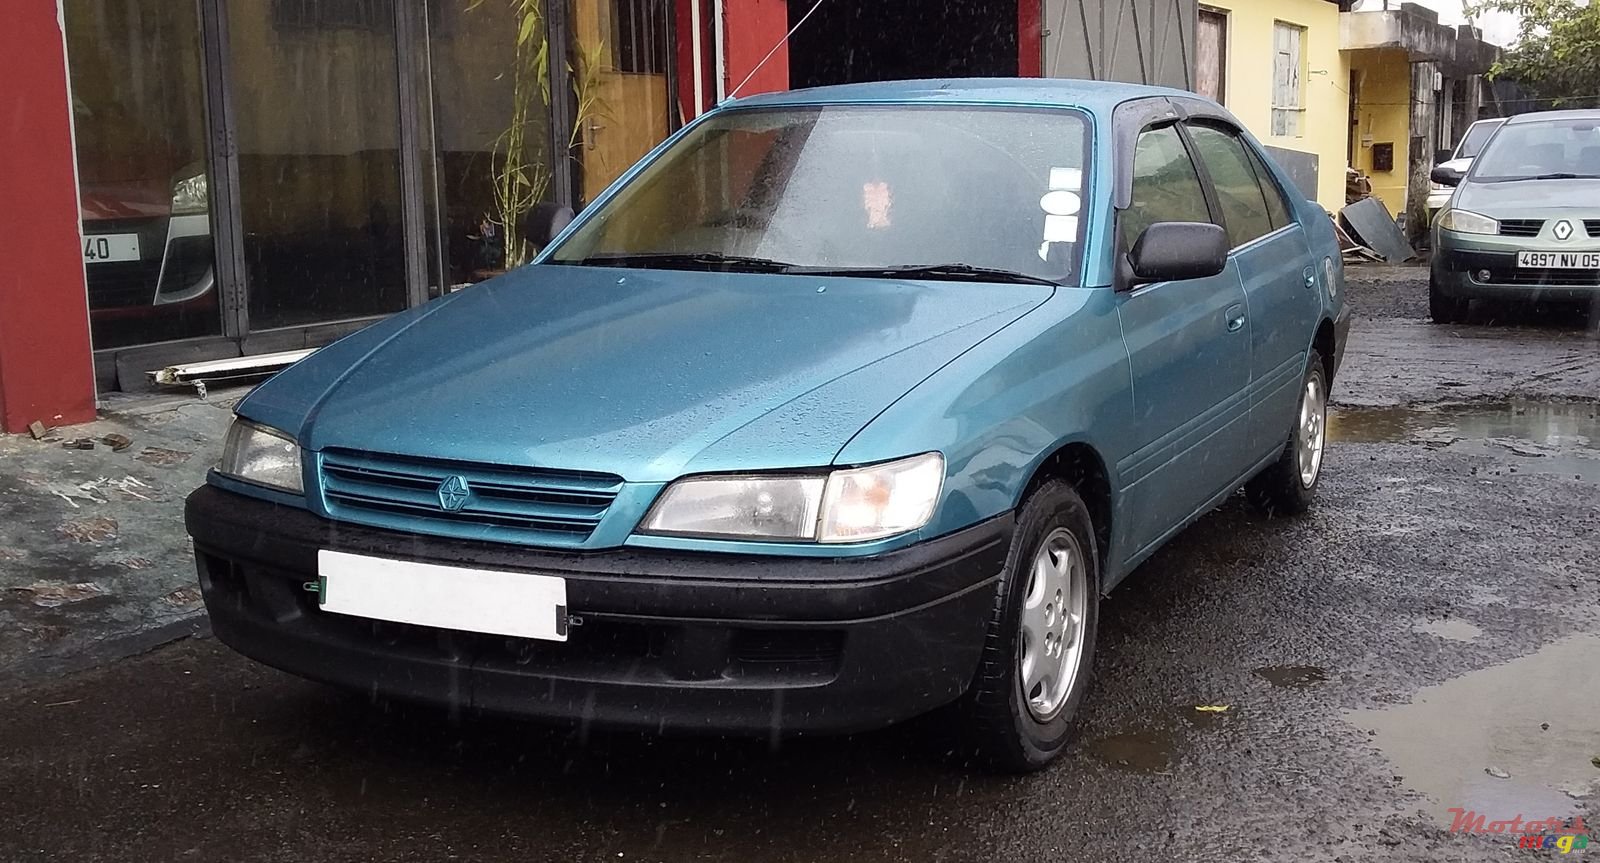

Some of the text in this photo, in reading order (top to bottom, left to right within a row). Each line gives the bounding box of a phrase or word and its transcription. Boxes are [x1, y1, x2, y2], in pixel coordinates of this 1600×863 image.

[85, 238, 109, 260] 40
[1522, 253, 1599, 267] 4897 NV 05
